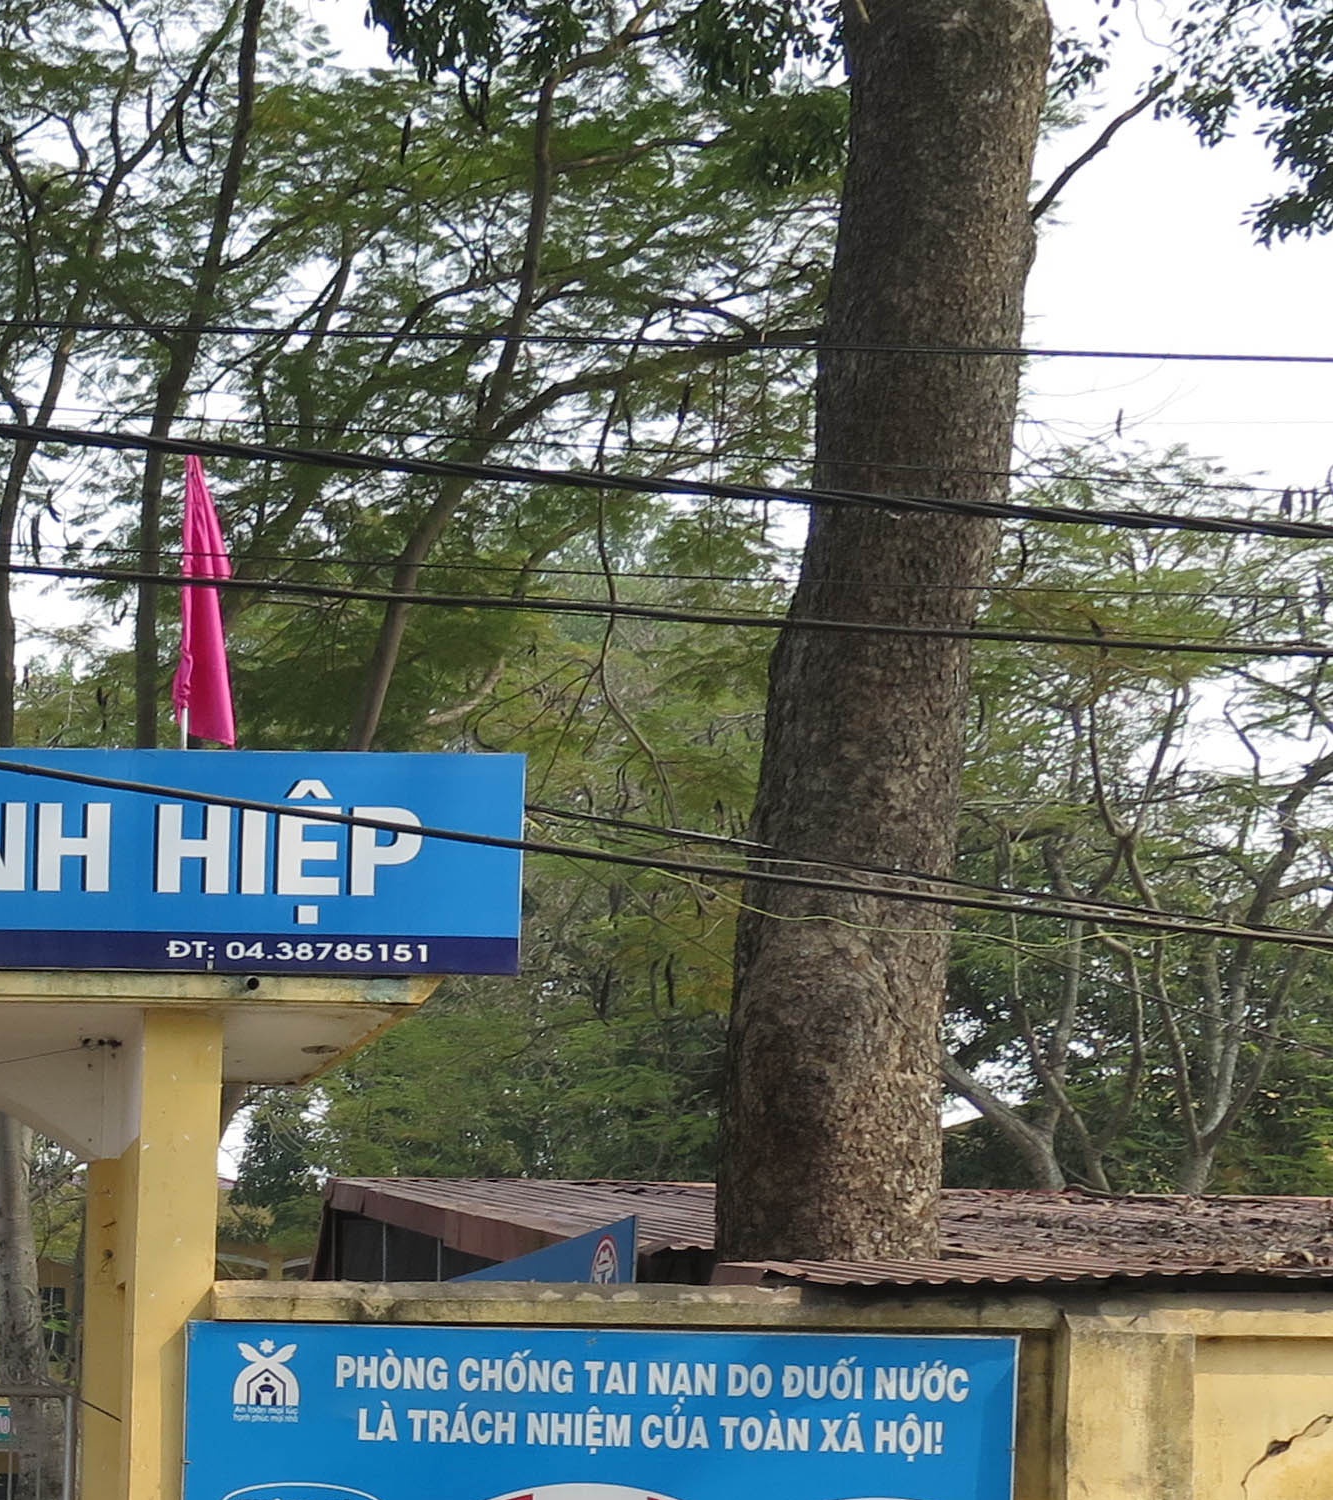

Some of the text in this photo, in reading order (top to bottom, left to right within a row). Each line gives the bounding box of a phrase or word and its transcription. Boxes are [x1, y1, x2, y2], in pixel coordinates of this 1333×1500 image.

[155, 778, 424, 925] HIỆP
[166, 940, 429, 962] ĐT: 04.38785151
[335, 1348, 970, 1404] PHÒNG CHỐNG TAI NẠN DO ĐUỐI NƯỚC
[356, 1400, 945, 1463] LÀ TRÁCH NHIỆM CỦA TOÀN XÃ HỘI!
